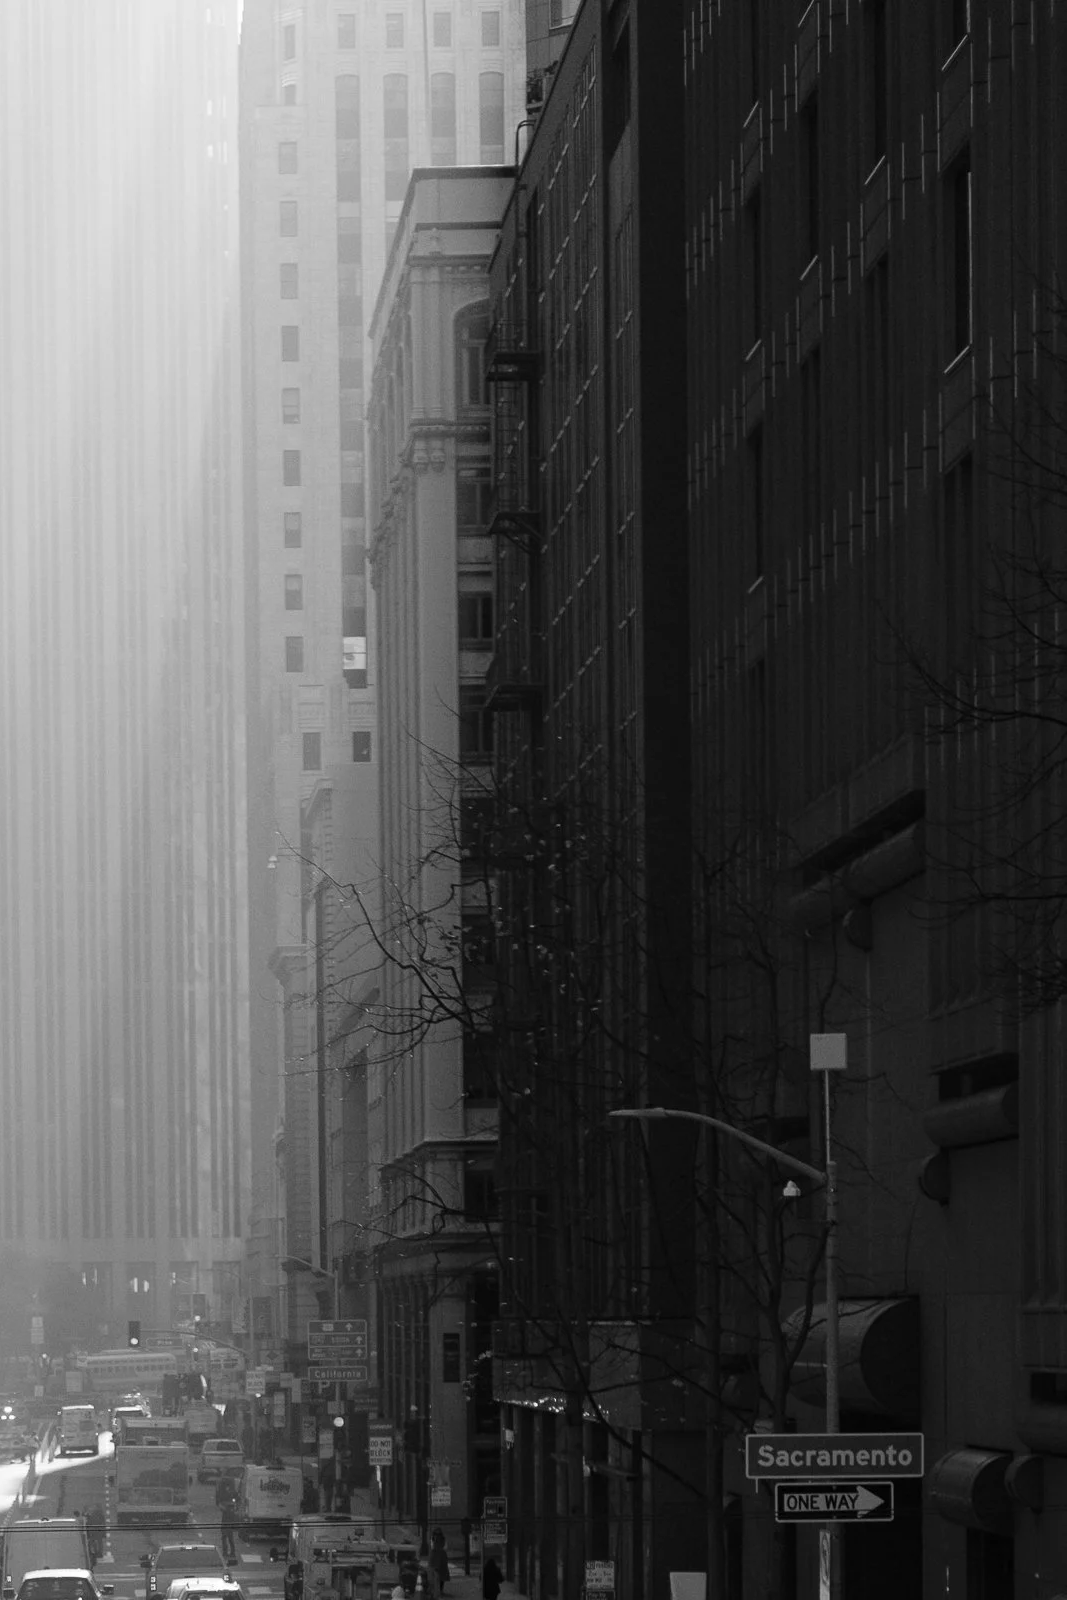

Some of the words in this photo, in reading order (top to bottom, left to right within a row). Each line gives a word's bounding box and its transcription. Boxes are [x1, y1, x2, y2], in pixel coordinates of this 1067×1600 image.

[315, 1370, 361, 1378] California
[380, 1440, 391, 1448] NOT
[369, 1449, 391, 1457] BLOCK
[757, 1444, 913, 1468] Sacramento
[786, 1495, 820, 1510] ONE
[824, 1493, 858, 1510] WAY
